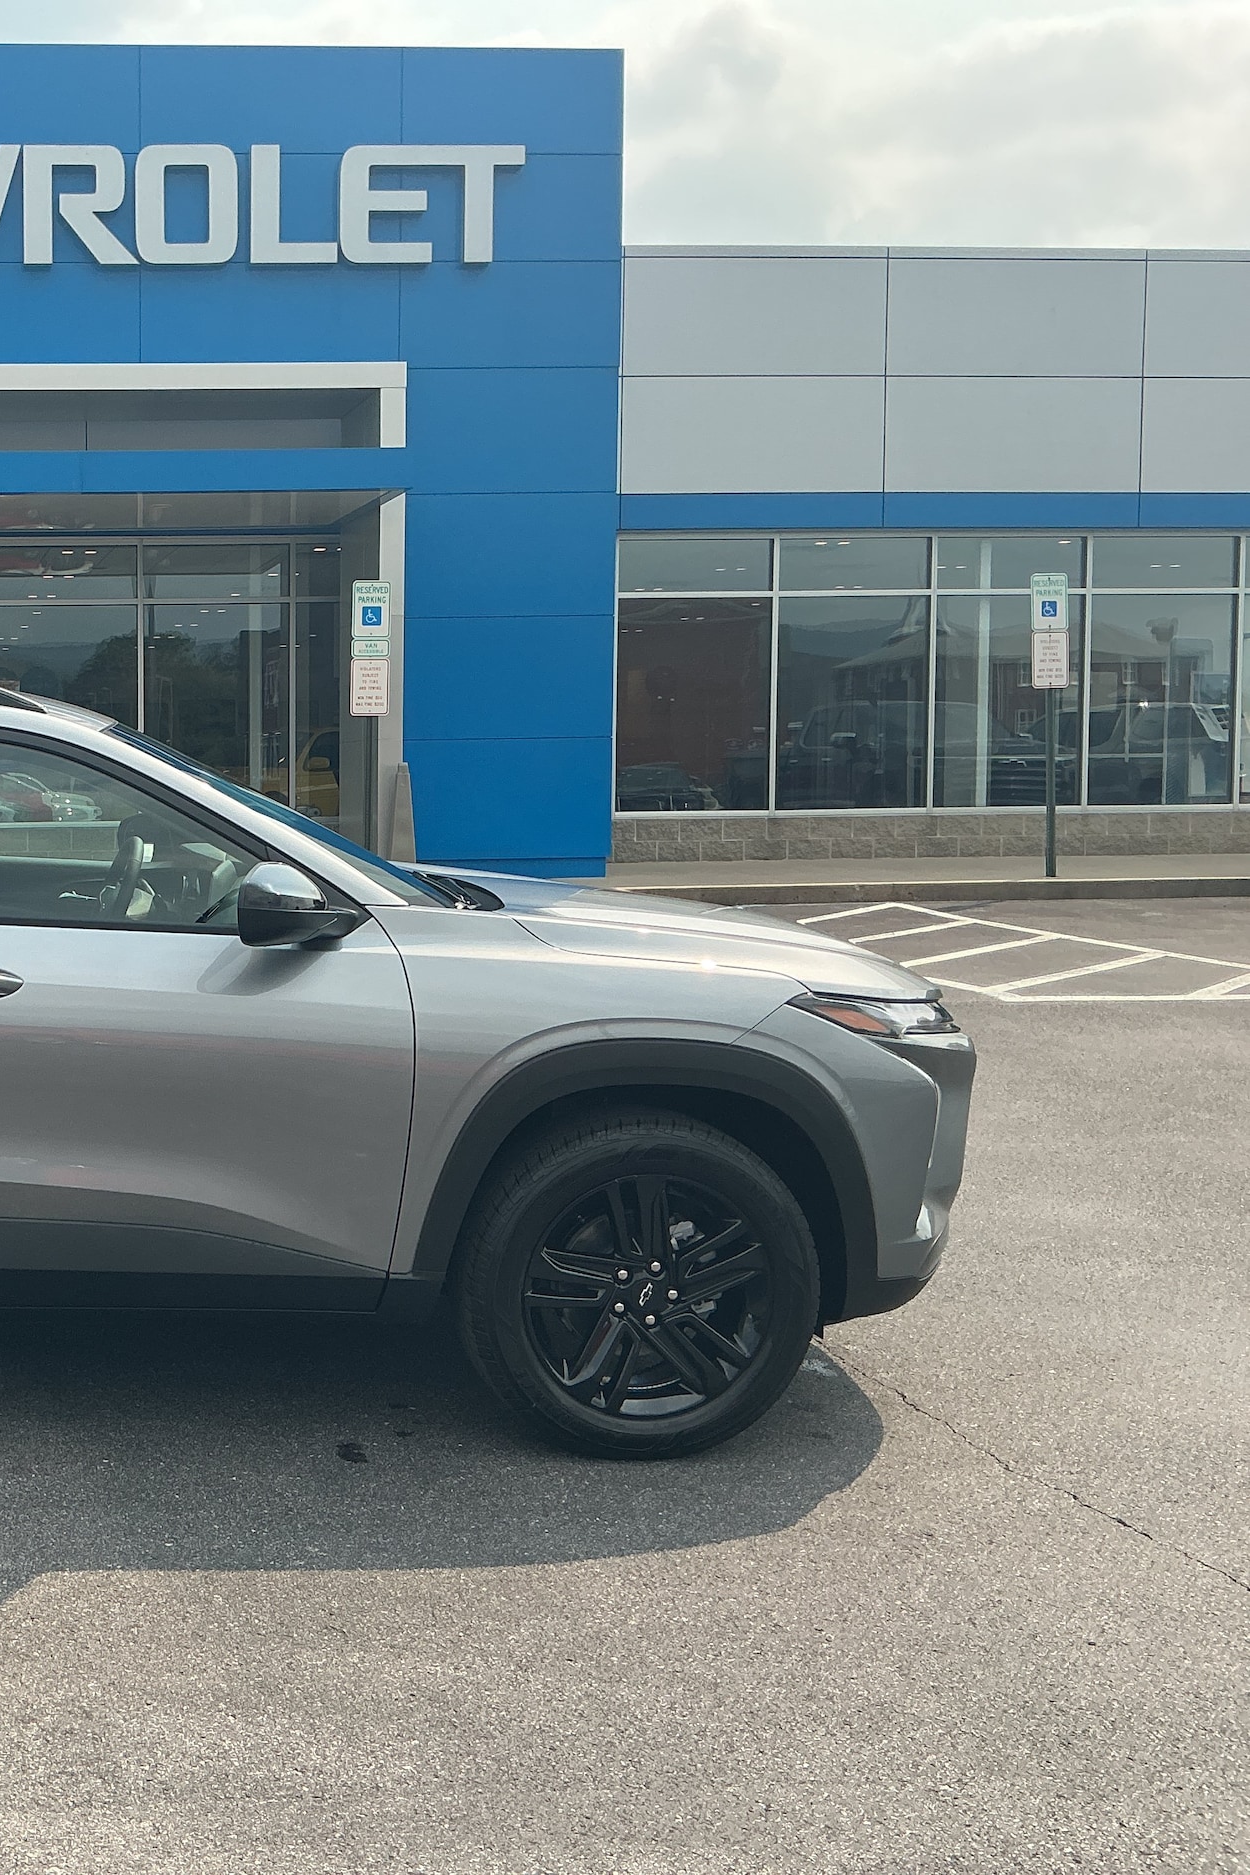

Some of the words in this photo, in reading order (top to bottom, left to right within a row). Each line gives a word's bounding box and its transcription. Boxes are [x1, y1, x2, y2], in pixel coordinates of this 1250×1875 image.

[1033, 579, 1064, 587] RESERVED
[356, 586, 389, 594] RESERVED
[1035, 589, 1063, 597] PARKING
[358, 596, 387, 604] PARKING
